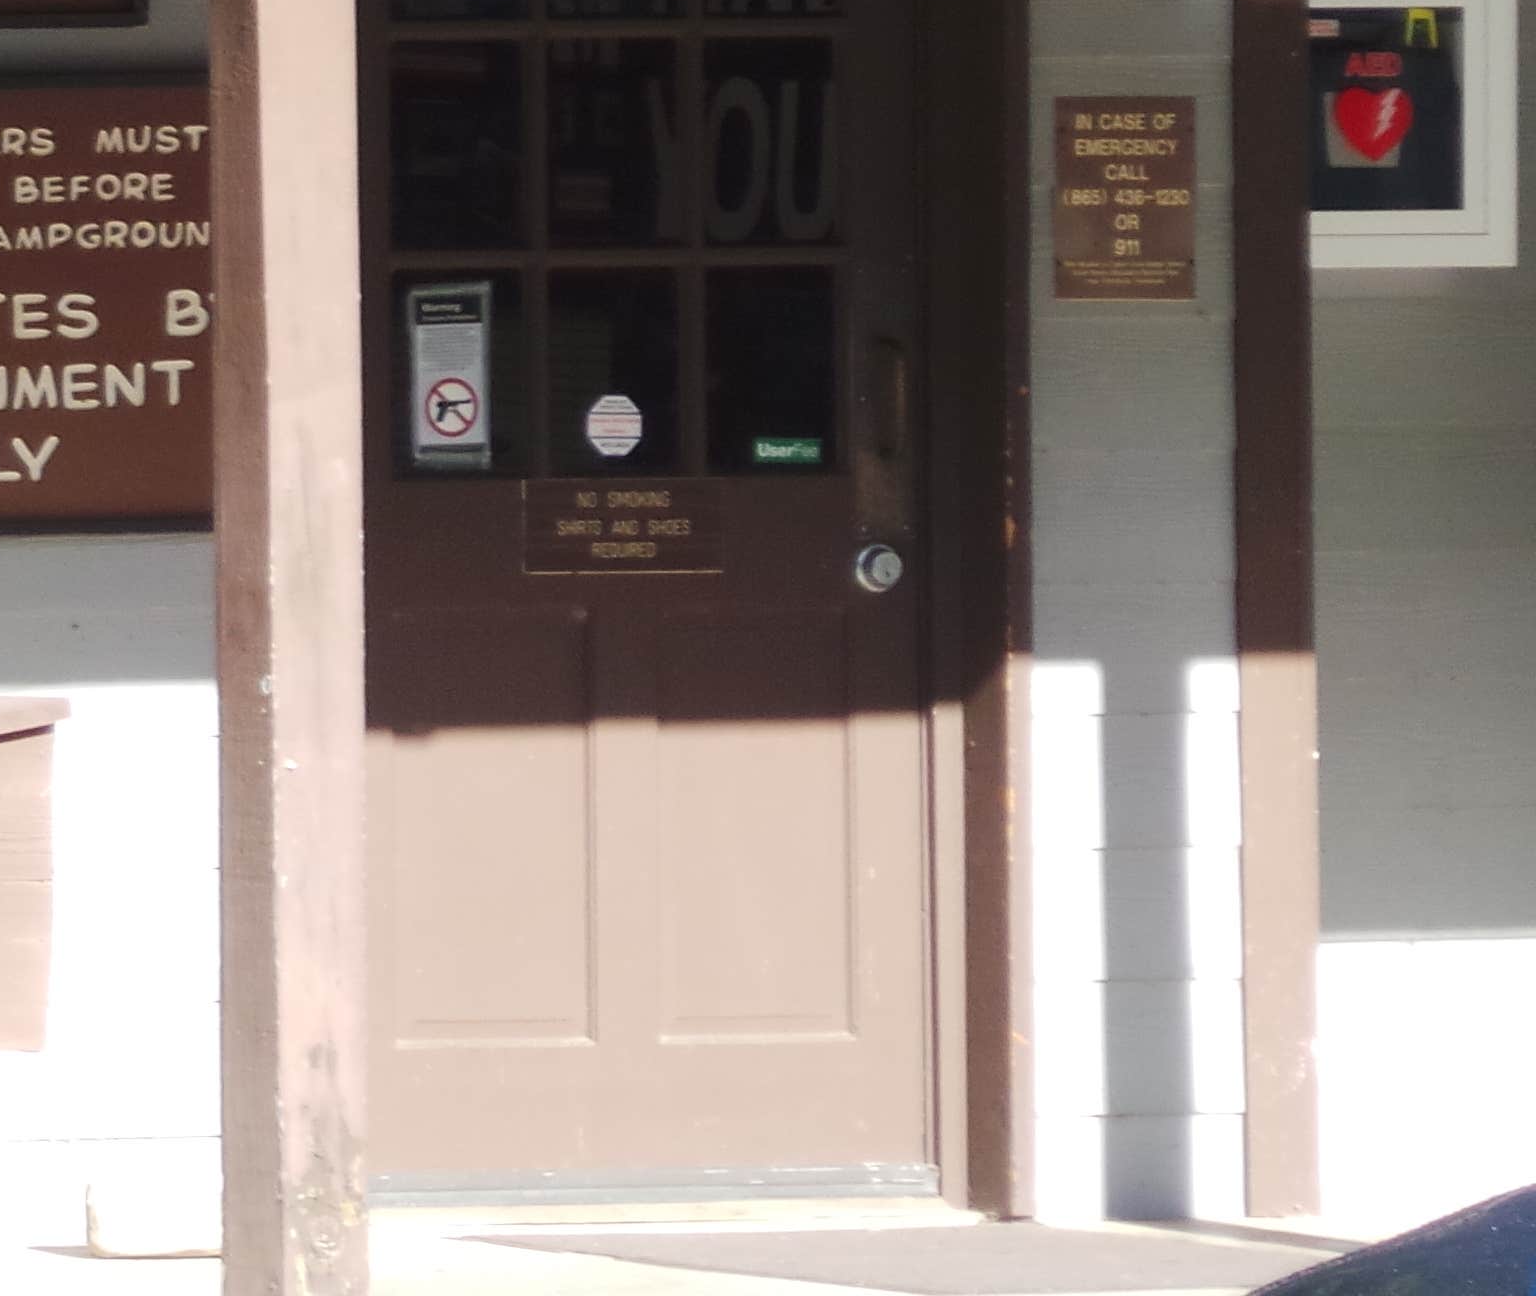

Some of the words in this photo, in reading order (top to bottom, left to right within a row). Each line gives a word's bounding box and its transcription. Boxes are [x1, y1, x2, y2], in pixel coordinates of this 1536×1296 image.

[1074, 114, 1093, 129] IN
[1099, 114, 1145, 129] CASE
[1152, 114, 1176, 129] OF
[95, 125, 211, 154] MUST
[1074, 139, 1178, 156] EMERGENCY
[1104, 164, 1148, 181] CALL
[13, 173, 176, 204] BEFORE
[1063, 189, 1107, 206] (865)
[1114, 214, 1140, 230] OR
[1114, 239, 1141, 256] 911
[164, 287, 213, 338] B
[576, 491, 598, 509] NO
[607, 490, 672, 508] SMOKING
[557, 519, 602, 536] SHIRTS
[612, 519, 639, 535] AND
[647, 518, 691, 535] SHOES
[591, 542, 656, 558] REQUIRED
